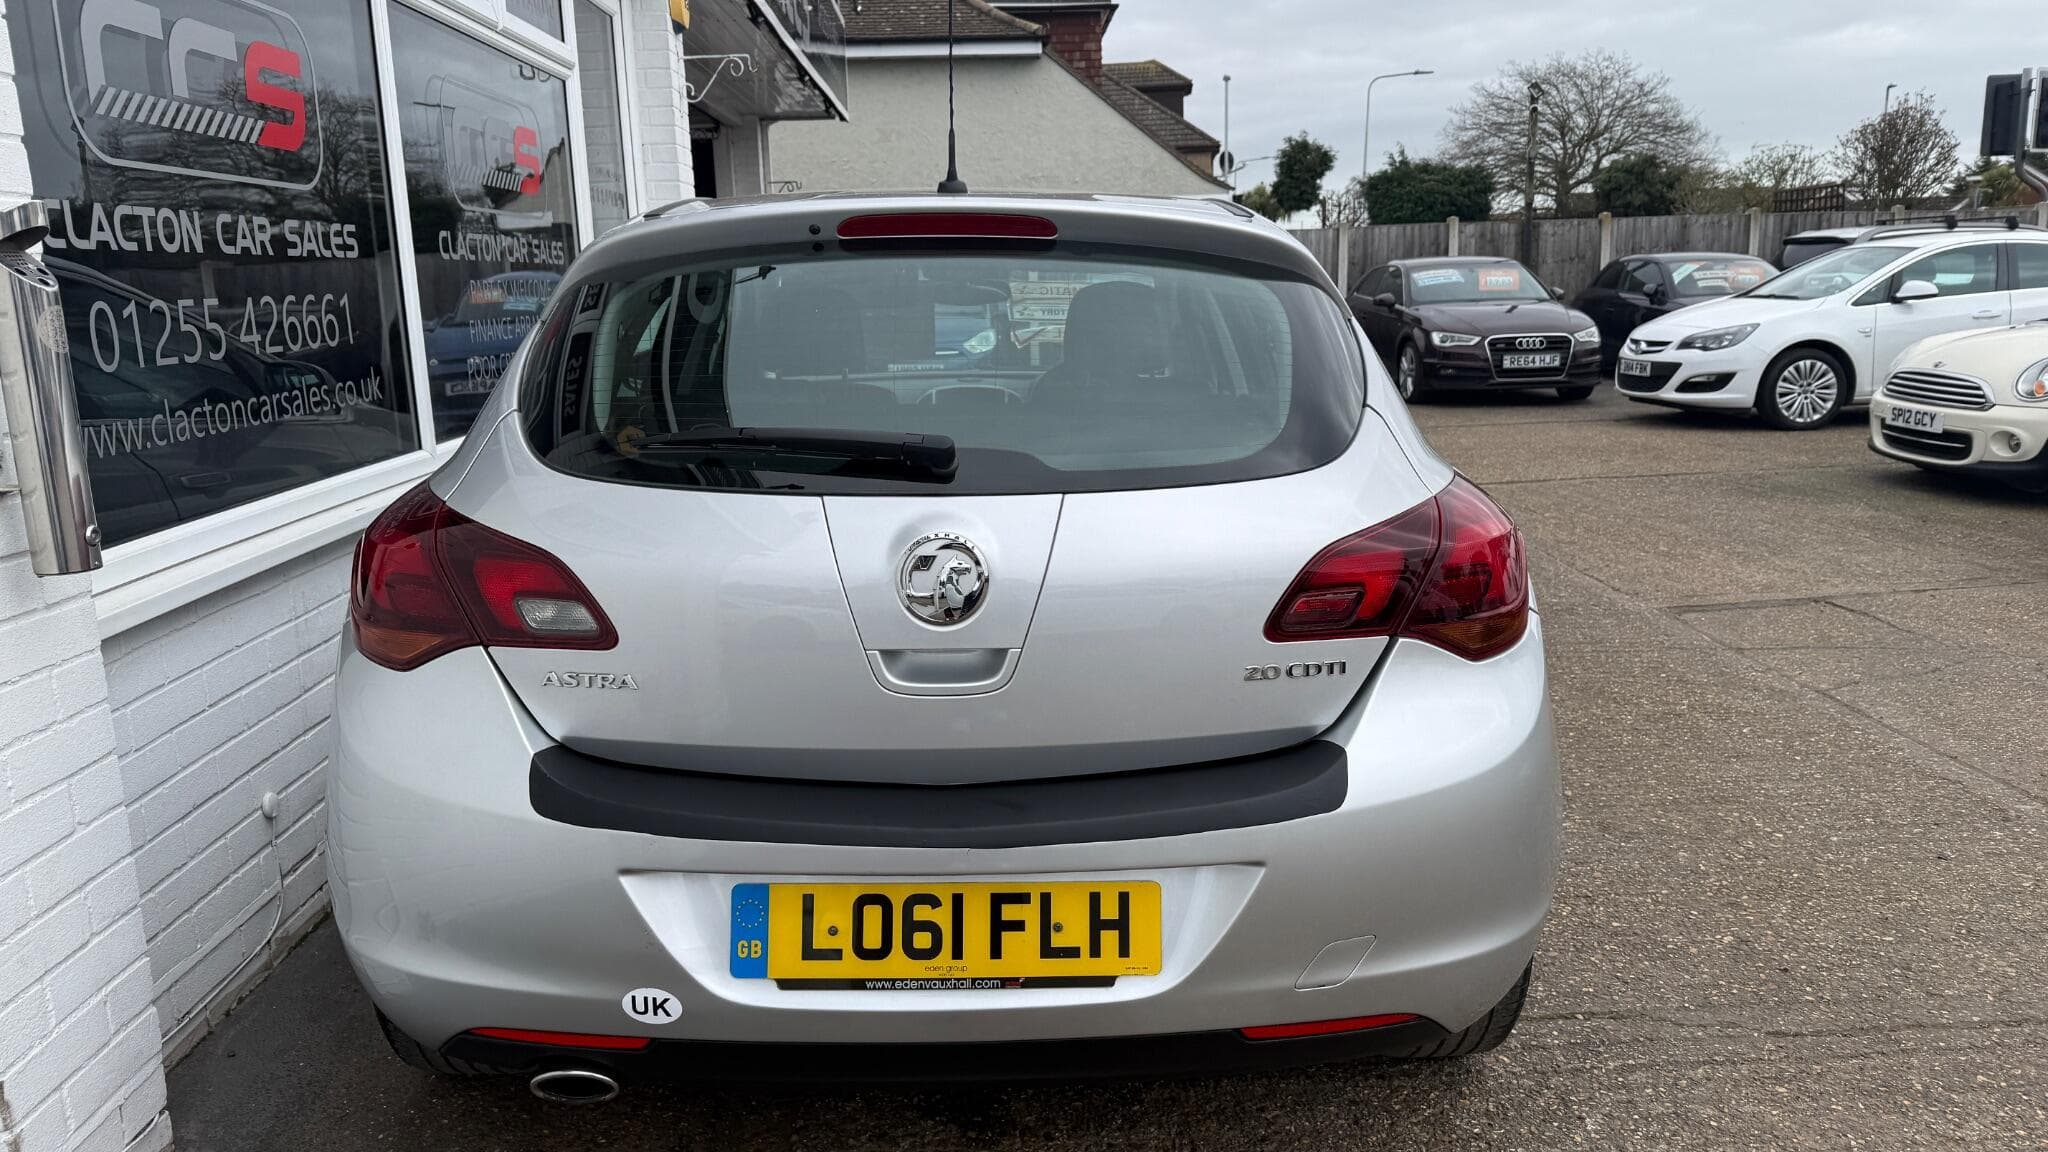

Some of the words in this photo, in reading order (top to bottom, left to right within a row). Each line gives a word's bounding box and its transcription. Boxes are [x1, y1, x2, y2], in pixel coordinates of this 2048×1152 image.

[44, 200, 204, 254] CLACTON
[215, 213, 274, 256] CAR
[283, 218, 359, 258] SALES
[438, 229, 501, 262] CLACTON
[505, 235, 529, 263] CAR
[532, 238, 565, 265] SALES
[89, 297, 228, 373] 01255
[239, 292, 357, 356] 426661
[469, 317, 513, 344] FINANCE
[515, 314, 540, 337] ARRA
[467, 355, 499, 387] POOR
[1510, 356, 1536, 367] RE64
[1538, 355, 1560, 366] HJF
[1891, 407, 1913, 425] SP12
[1914, 410, 1937, 428] GCY
[1285, 660, 1347, 679] CDTI
[541, 671, 640, 691] ASTRA
[801, 892, 965, 962] LO61
[989, 891, 1131, 961] FLH
[737, 940, 763, 959] GB
[924, 964, 944, 972] eden
[945, 965, 968, 974] group
[865, 977, 1001, 990] www.edenvauxhall.com
[631, 995, 673, 1018] UK
